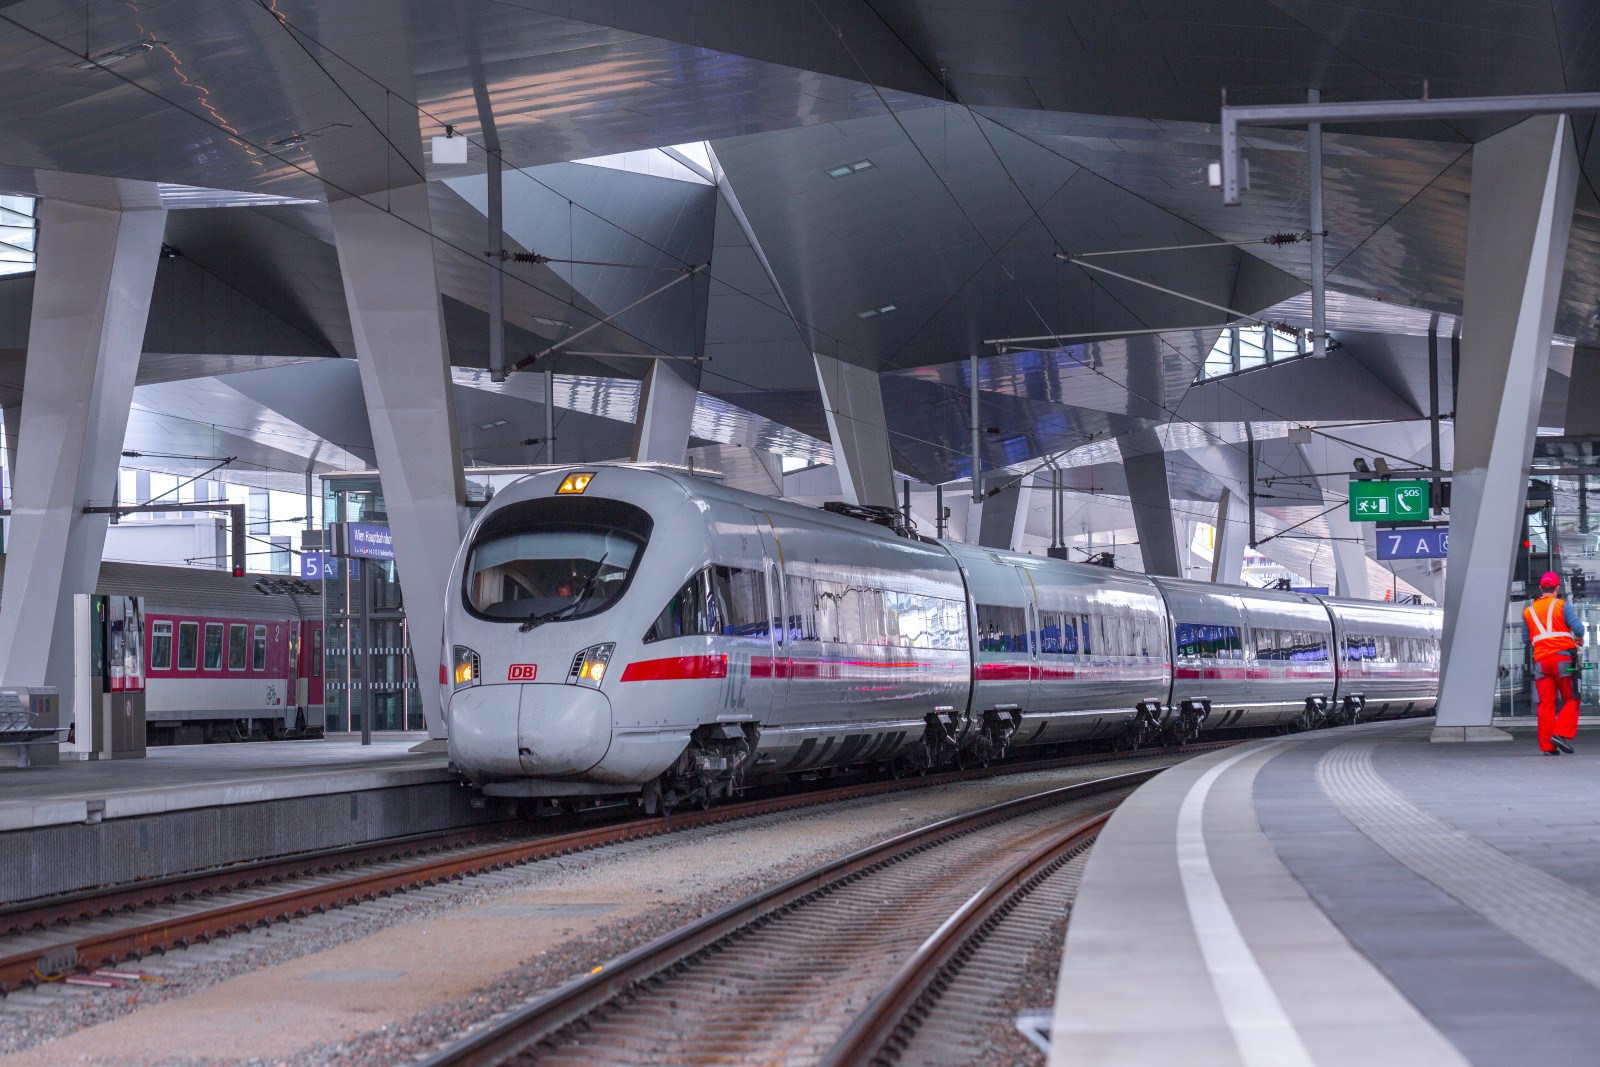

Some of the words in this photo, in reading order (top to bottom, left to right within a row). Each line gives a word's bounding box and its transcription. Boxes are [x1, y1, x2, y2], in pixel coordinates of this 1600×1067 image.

[1404, 489, 1420, 497] SOS
[1388, 535, 1402, 555] 7
[1415, 538, 1430, 554] A
[306, 558, 318, 576] 5
[274, 625, 280, 642] 2
[511, 666, 534, 678] DB
[723, 651, 749, 709] ICE
